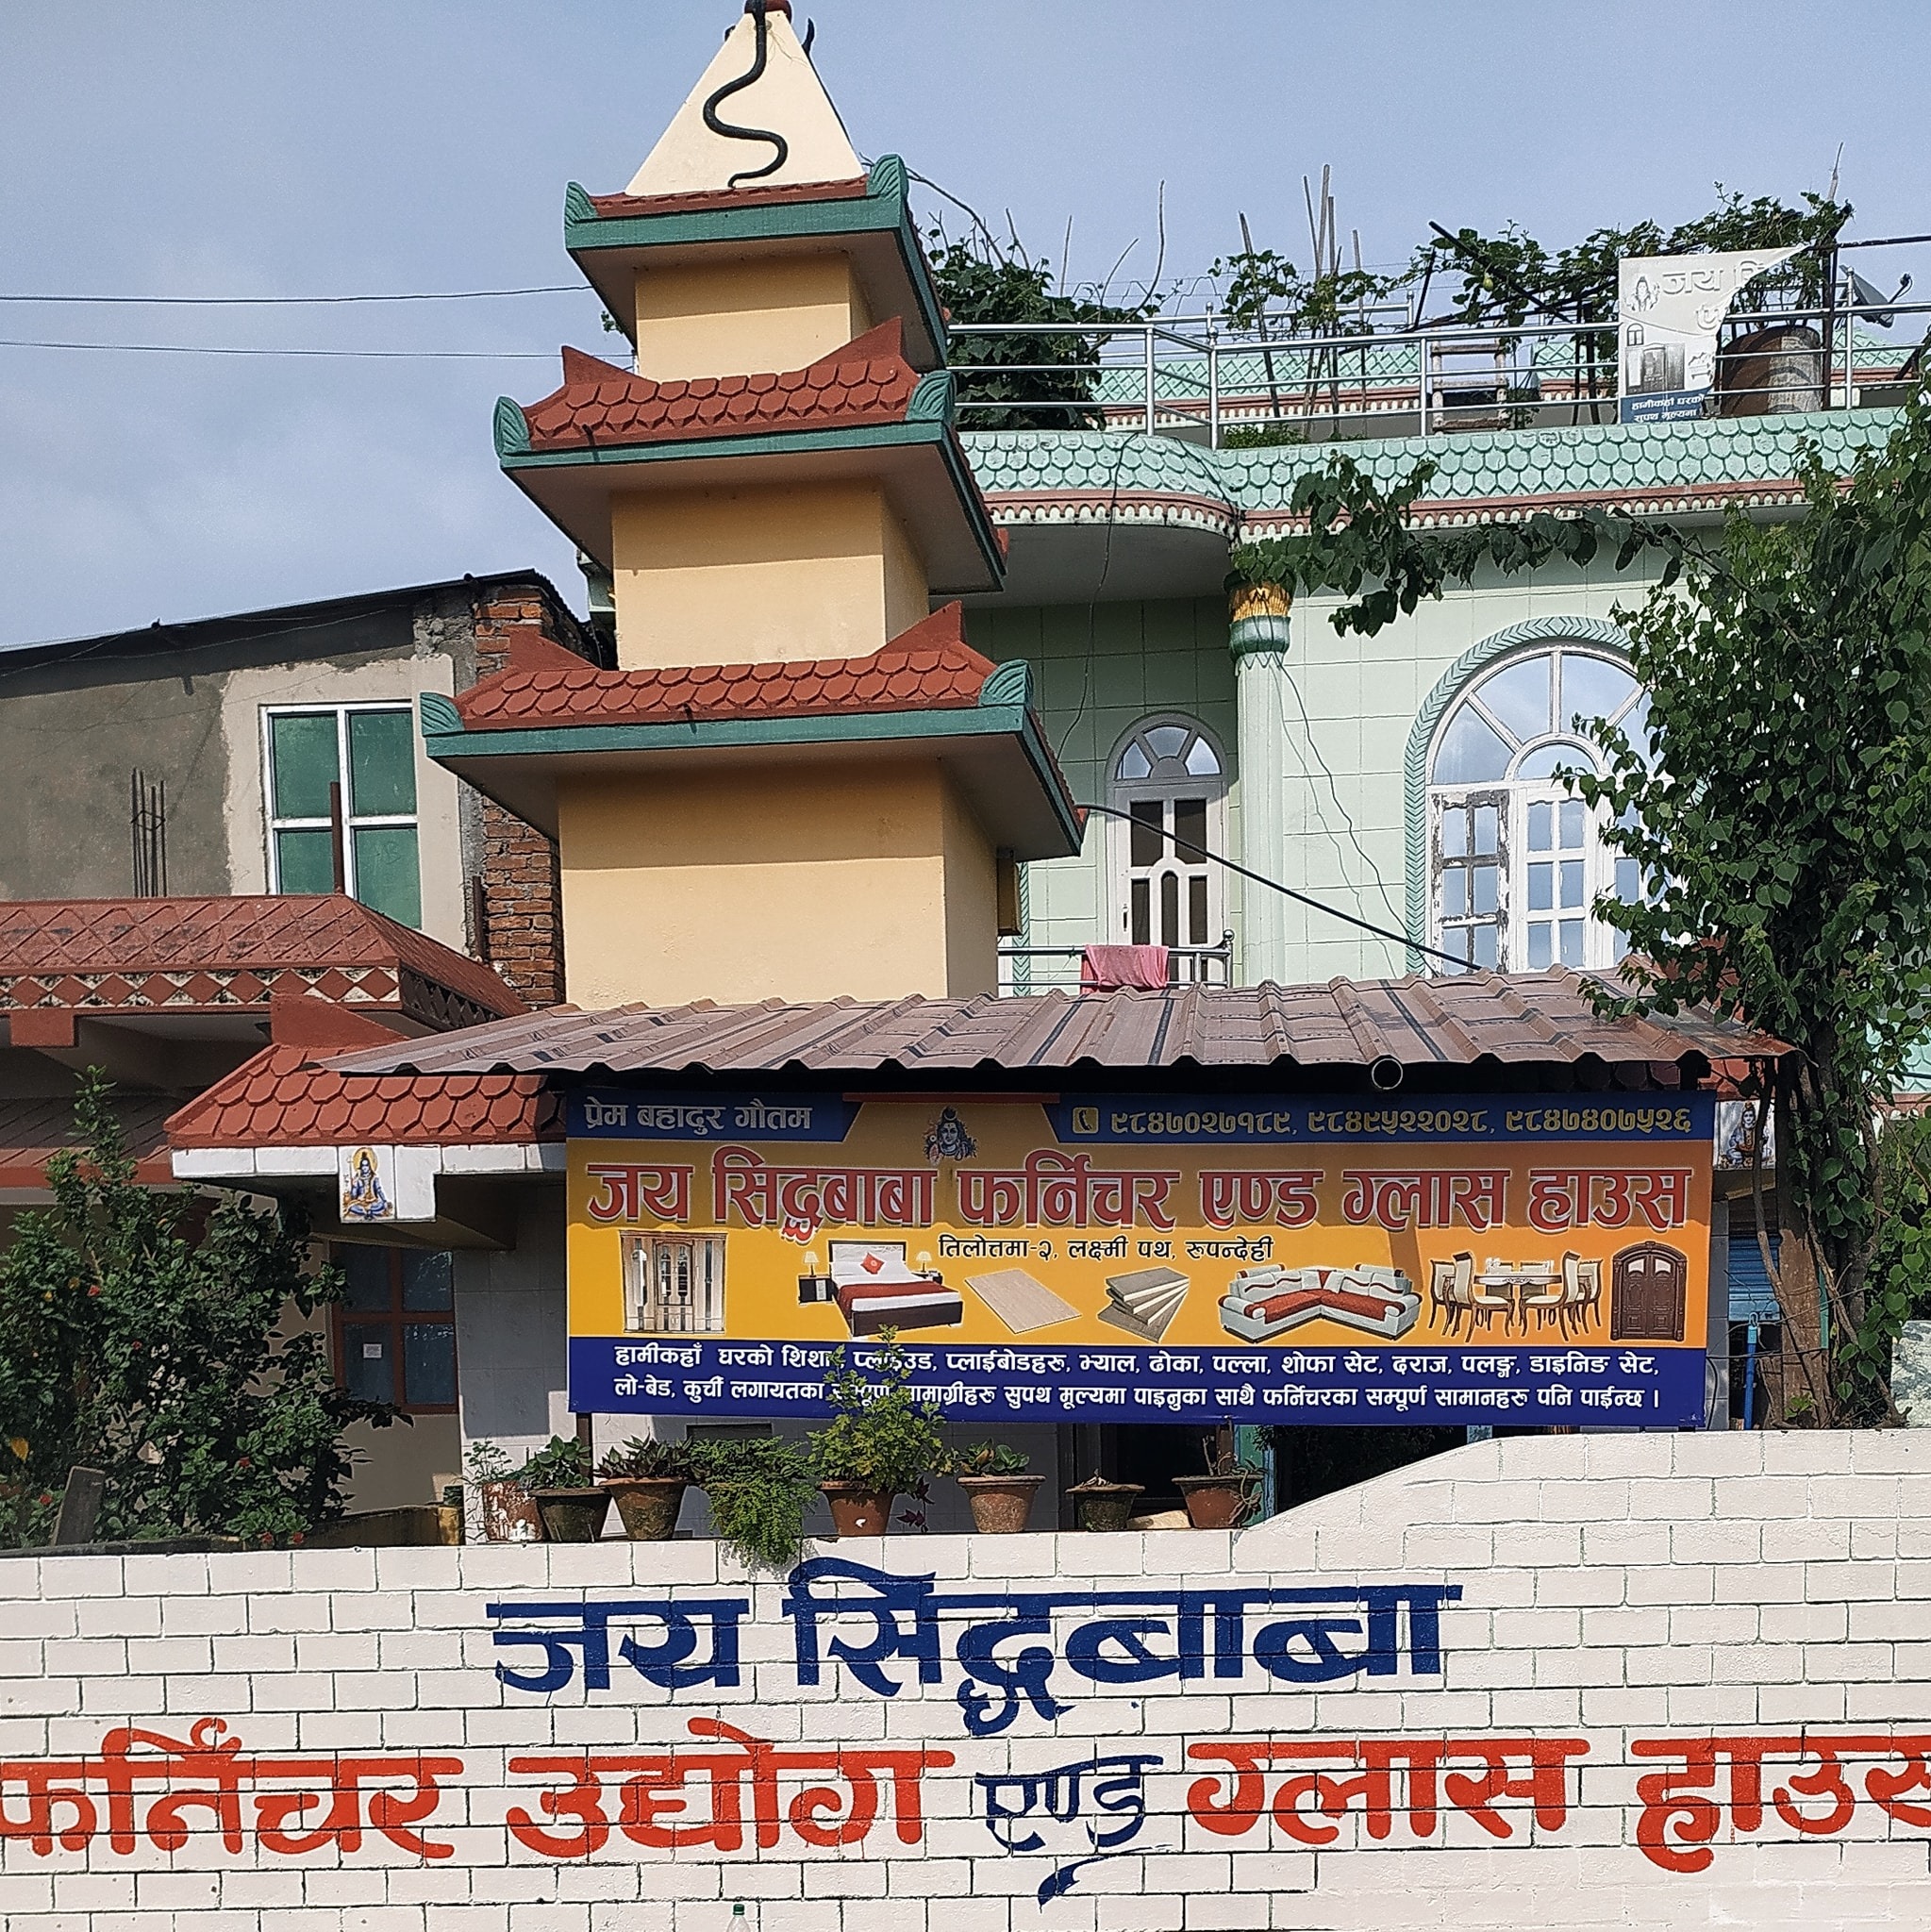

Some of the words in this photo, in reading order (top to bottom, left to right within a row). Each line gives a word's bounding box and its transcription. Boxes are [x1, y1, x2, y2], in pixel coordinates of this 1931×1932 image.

[1662, 270, 1723, 295] जय
[585, 1097, 627, 1128] प्रेम
[638, 1106, 725, 1135] बहादुर
[735, 1099, 812, 1129] गौतम
[1112, 1112, 1296, 1134] ९८४७०२७१८९,
[1507, 1108, 1690, 1133] ९८४७४०७५२६
[587, 1163, 695, 1223] जय
[711, 1145, 939, 1245] सिद्धबाबा
[955, 1148, 1181, 1231] फर्निचर
[1198, 1170, 1324, 1230] एण्ड
[1342, 1169, 1511, 1231] ग्लास
[1528, 1168, 1693, 1232] हाउस
[1068, 1236, 1128, 1260] लक्ष्मी
[1138, 1241, 1174, 1258] पथ,
[1186, 1237, 1273, 1261] रूपन्देही
[615, 1342, 702, 1367] हामीकहाँ
[718, 1344, 774, 1365] घरको
[1149, 1351, 1203, 1374] ढोका,
[1212, 1357, 1271, 1374] पल्ला,
[1282, 1351, 1336, 1374] शोफा
[1343, 1351, 1382, 1374] सेट,
[1392, 1357, 1451, 1374] दराज,
[1530, 1351, 1610, 1374] डाइनिङ
[1619, 1351, 1657, 1374] सेट,
[614, 1374, 674, 1397] लो-बेड,
[730, 1381, 824, 1399] लगायतका
[1004, 1387, 1052, 1408] सुपथ
[1058, 1388, 1126, 1409] मूल्यमा
[1134, 1389, 1207, 1410] पाइनुका
[1215, 1384, 1255, 1405] साथै
[1263, 1385, 1358, 1405] फर्निचरका
[1366, 1386, 1427, 1411] सम्पूर्ण
[1537, 1384, 1573, 1405] पनि
[1580, 1386, 1644, 1408] पाईन्छ
[488, 1600, 747, 1690] जय
[783, 1559, 1460, 1735] सिद्धबाबा
[508, 1719, 954, 1856] उद्योग
[981, 1757, 1161, 1849] एण्ड
[1189, 1740, 1589, 1843] ग्लास
